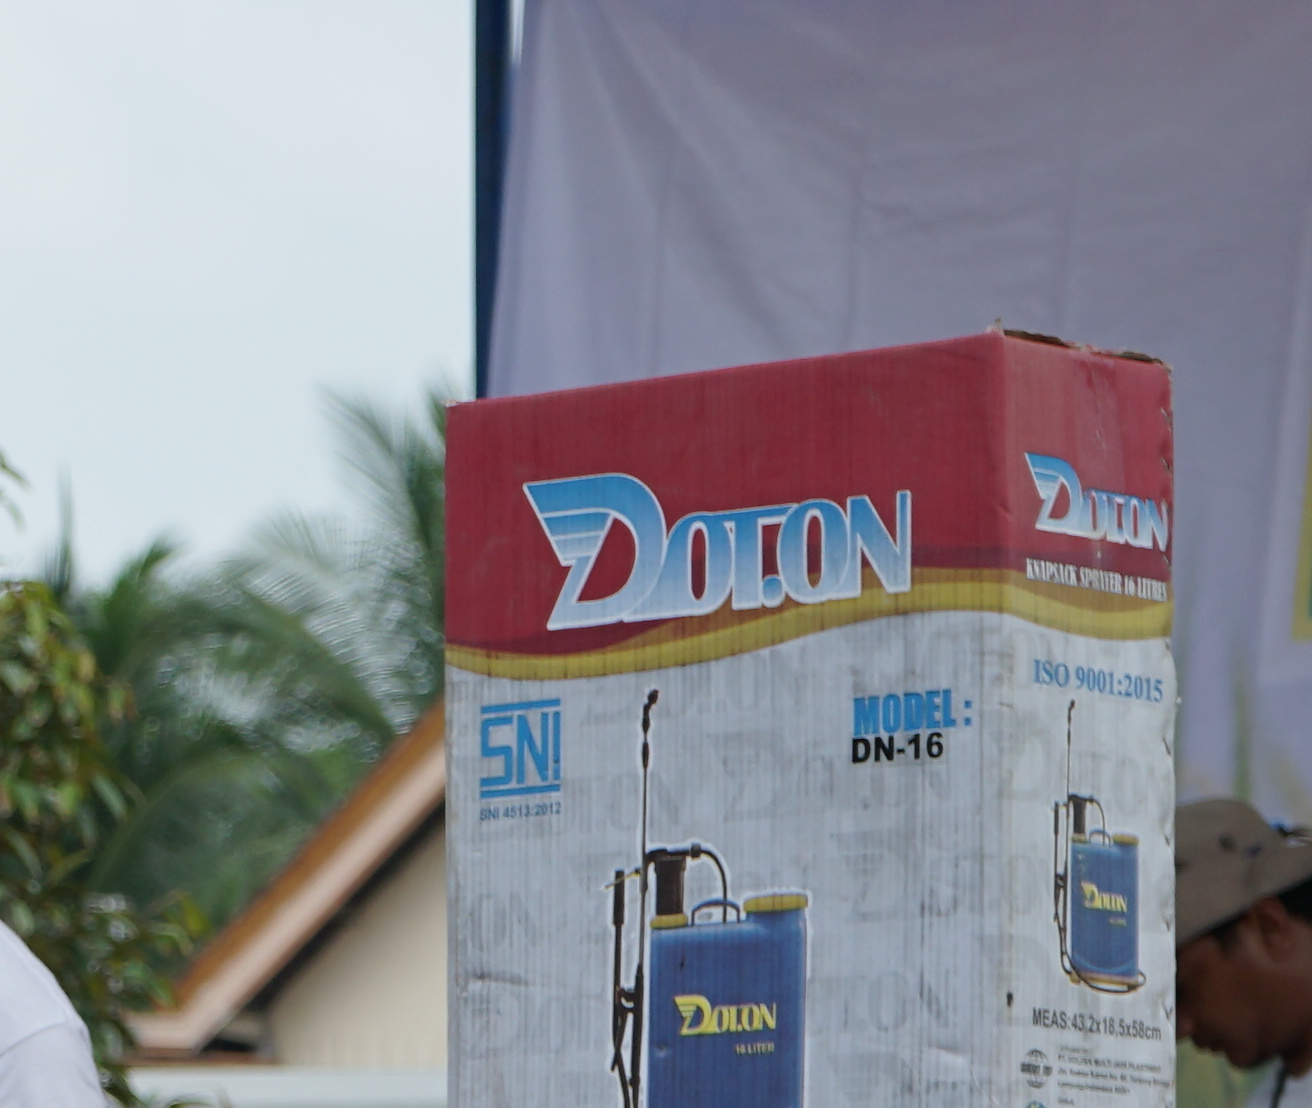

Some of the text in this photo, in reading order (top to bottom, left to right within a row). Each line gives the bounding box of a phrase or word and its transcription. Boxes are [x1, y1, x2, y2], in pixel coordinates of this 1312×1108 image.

[1026, 558, 1078, 588] KNAPSACK
[1079, 566, 1122, 596] SPRAYER
[1137, 576, 1168, 602] LITRES
[1033, 659, 1164, 703] ISO 9001:2015
[480, 710, 561, 788] SNI
[852, 732, 944, 764] DN-16
[480, 807, 500, 821] SNI
